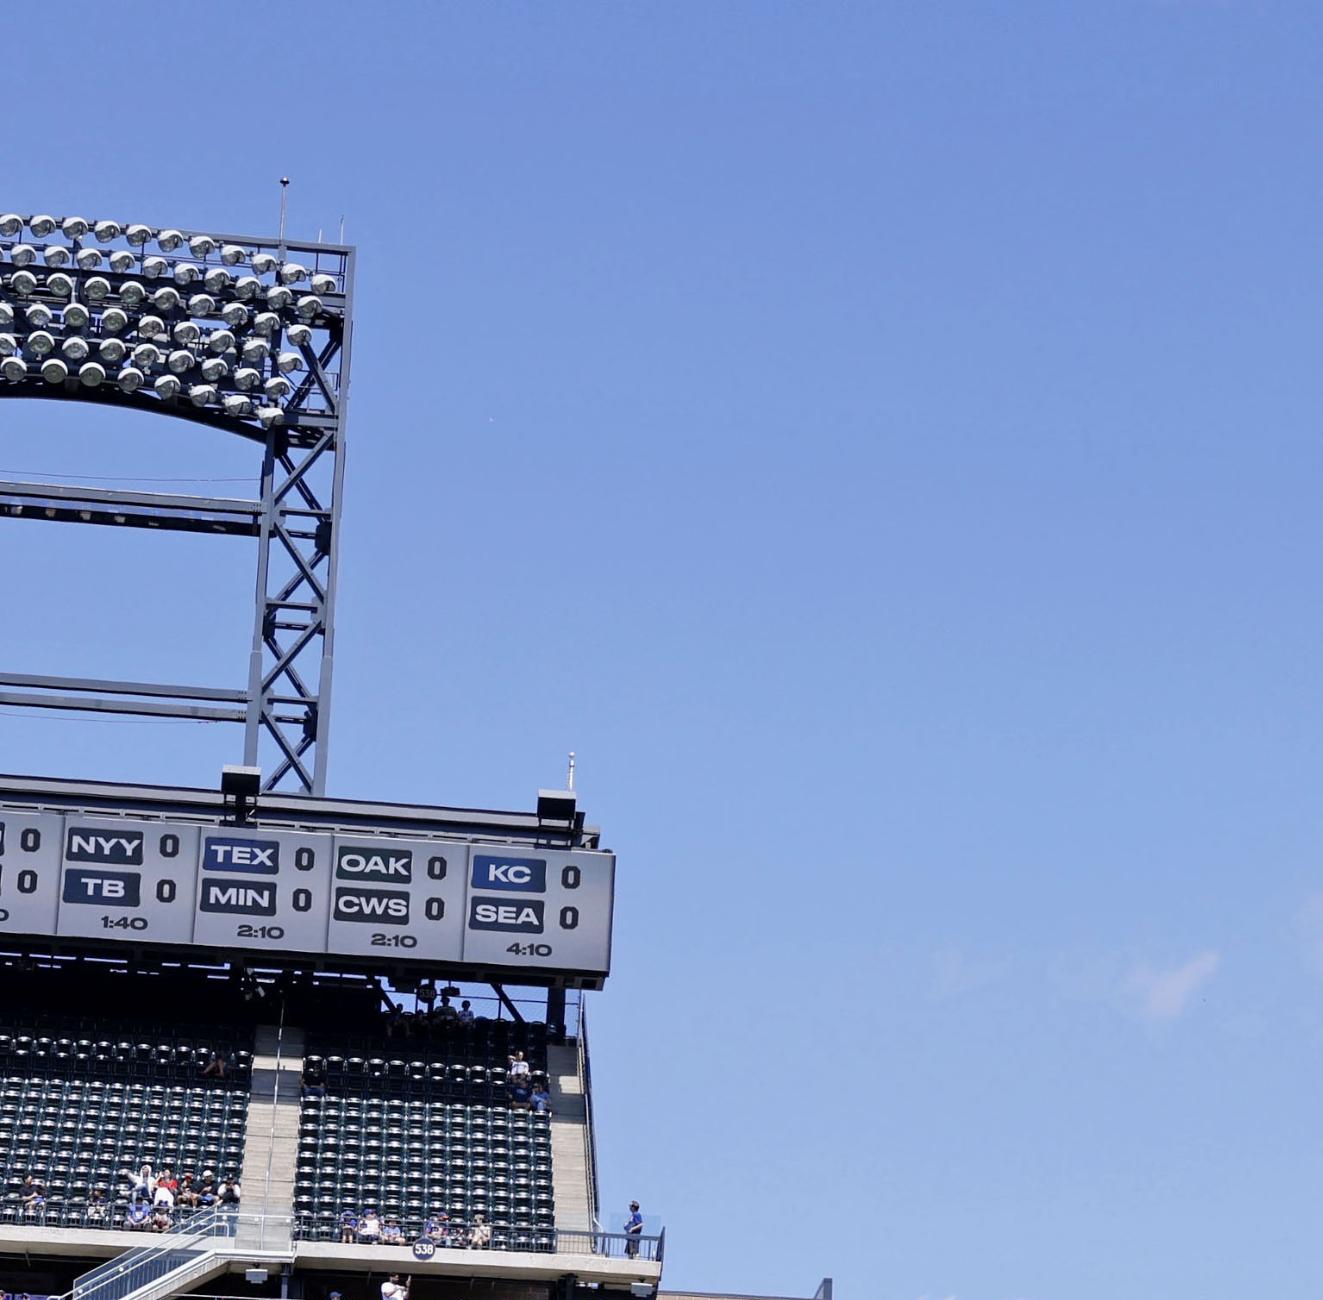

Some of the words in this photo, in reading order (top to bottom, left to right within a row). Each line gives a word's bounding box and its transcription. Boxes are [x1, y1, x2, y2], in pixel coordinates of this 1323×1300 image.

[71, 836, 141, 857] NYY
[210, 845, 274, 866] TEX
[340, 854, 410, 876] OAK
[488, 864, 532, 883] KC
[80, 878, 126, 898] TB
[209, 887, 270, 908] MIN
[338, 896, 408, 916] CWS
[475, 904, 540, 925] SEA
[101, 916, 148, 930] 1:40
[237, 924, 285, 939] 2:10
[371, 933, 417, 948] 2:10
[506, 943, 553, 957] 4:10
